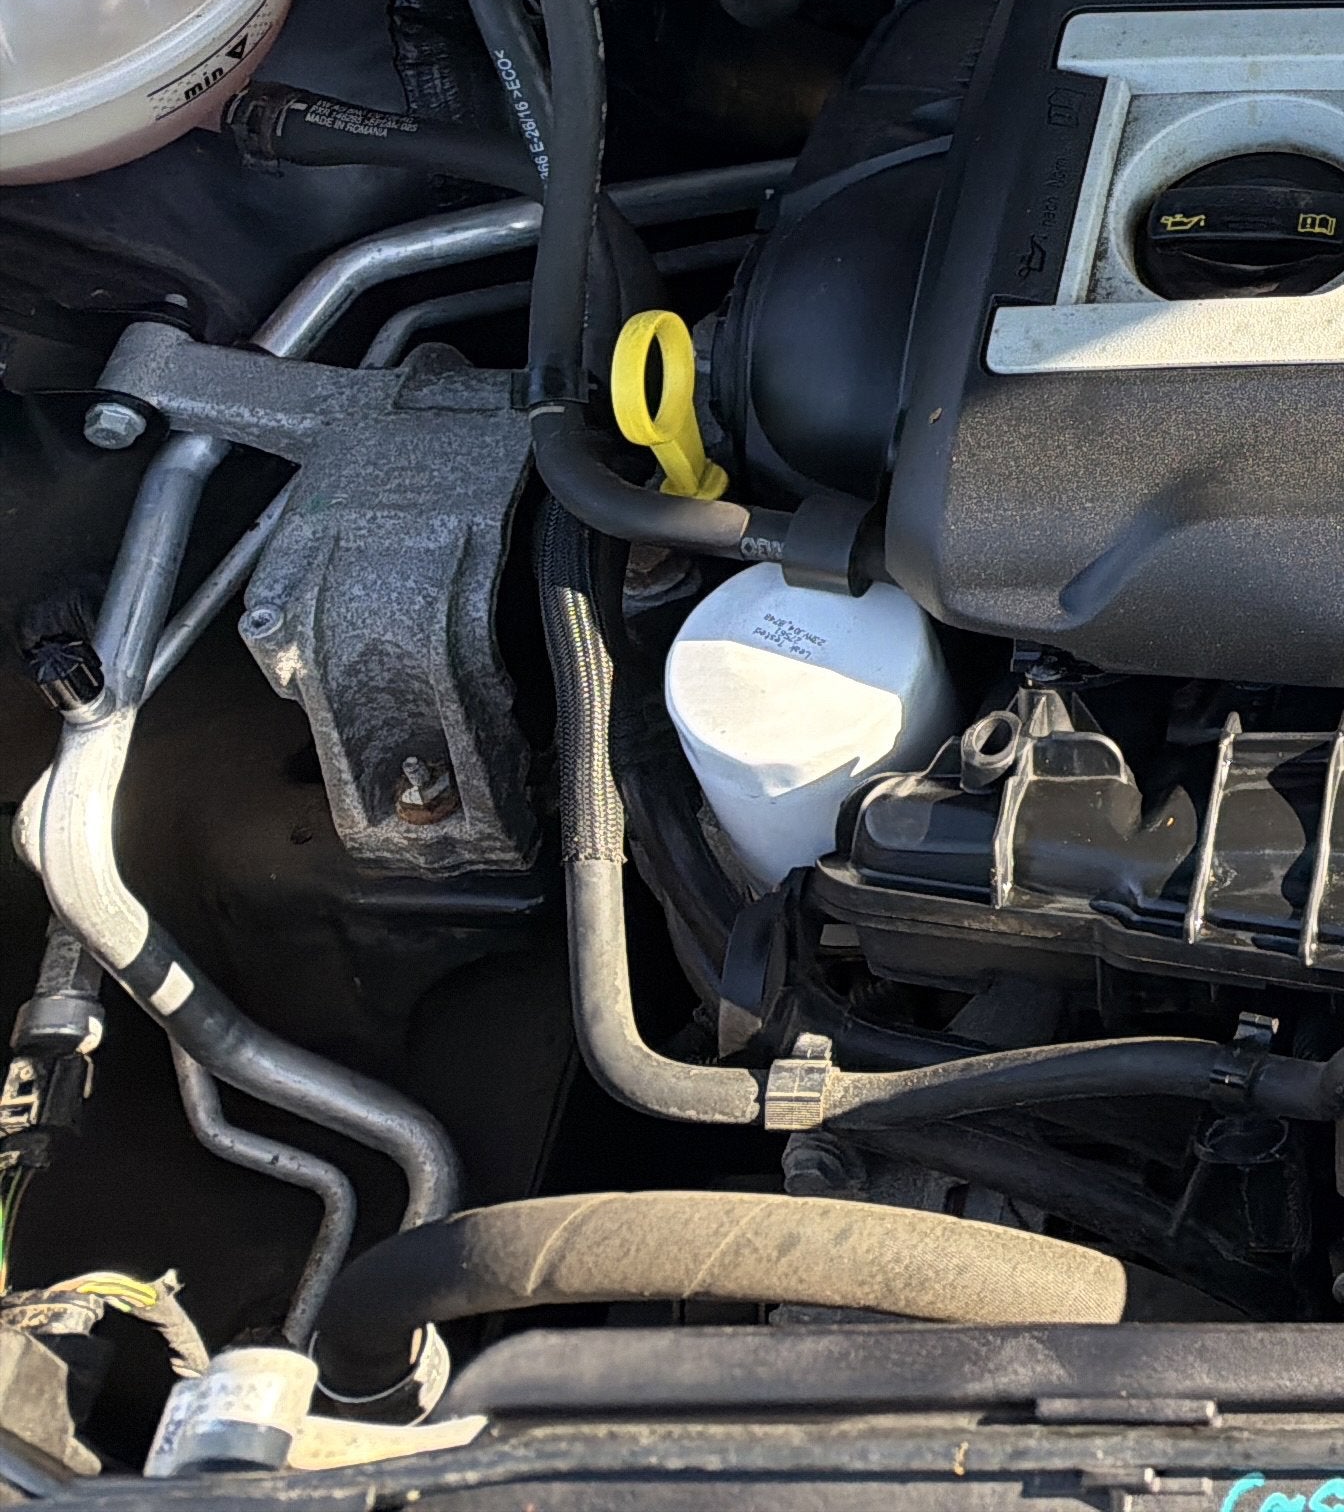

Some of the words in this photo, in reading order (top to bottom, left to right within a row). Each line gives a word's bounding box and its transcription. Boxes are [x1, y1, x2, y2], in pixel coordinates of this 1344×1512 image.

[184, 66, 224, 101] min
[305, 113, 334, 128] MADE
[333, 119, 345, 130] IN
